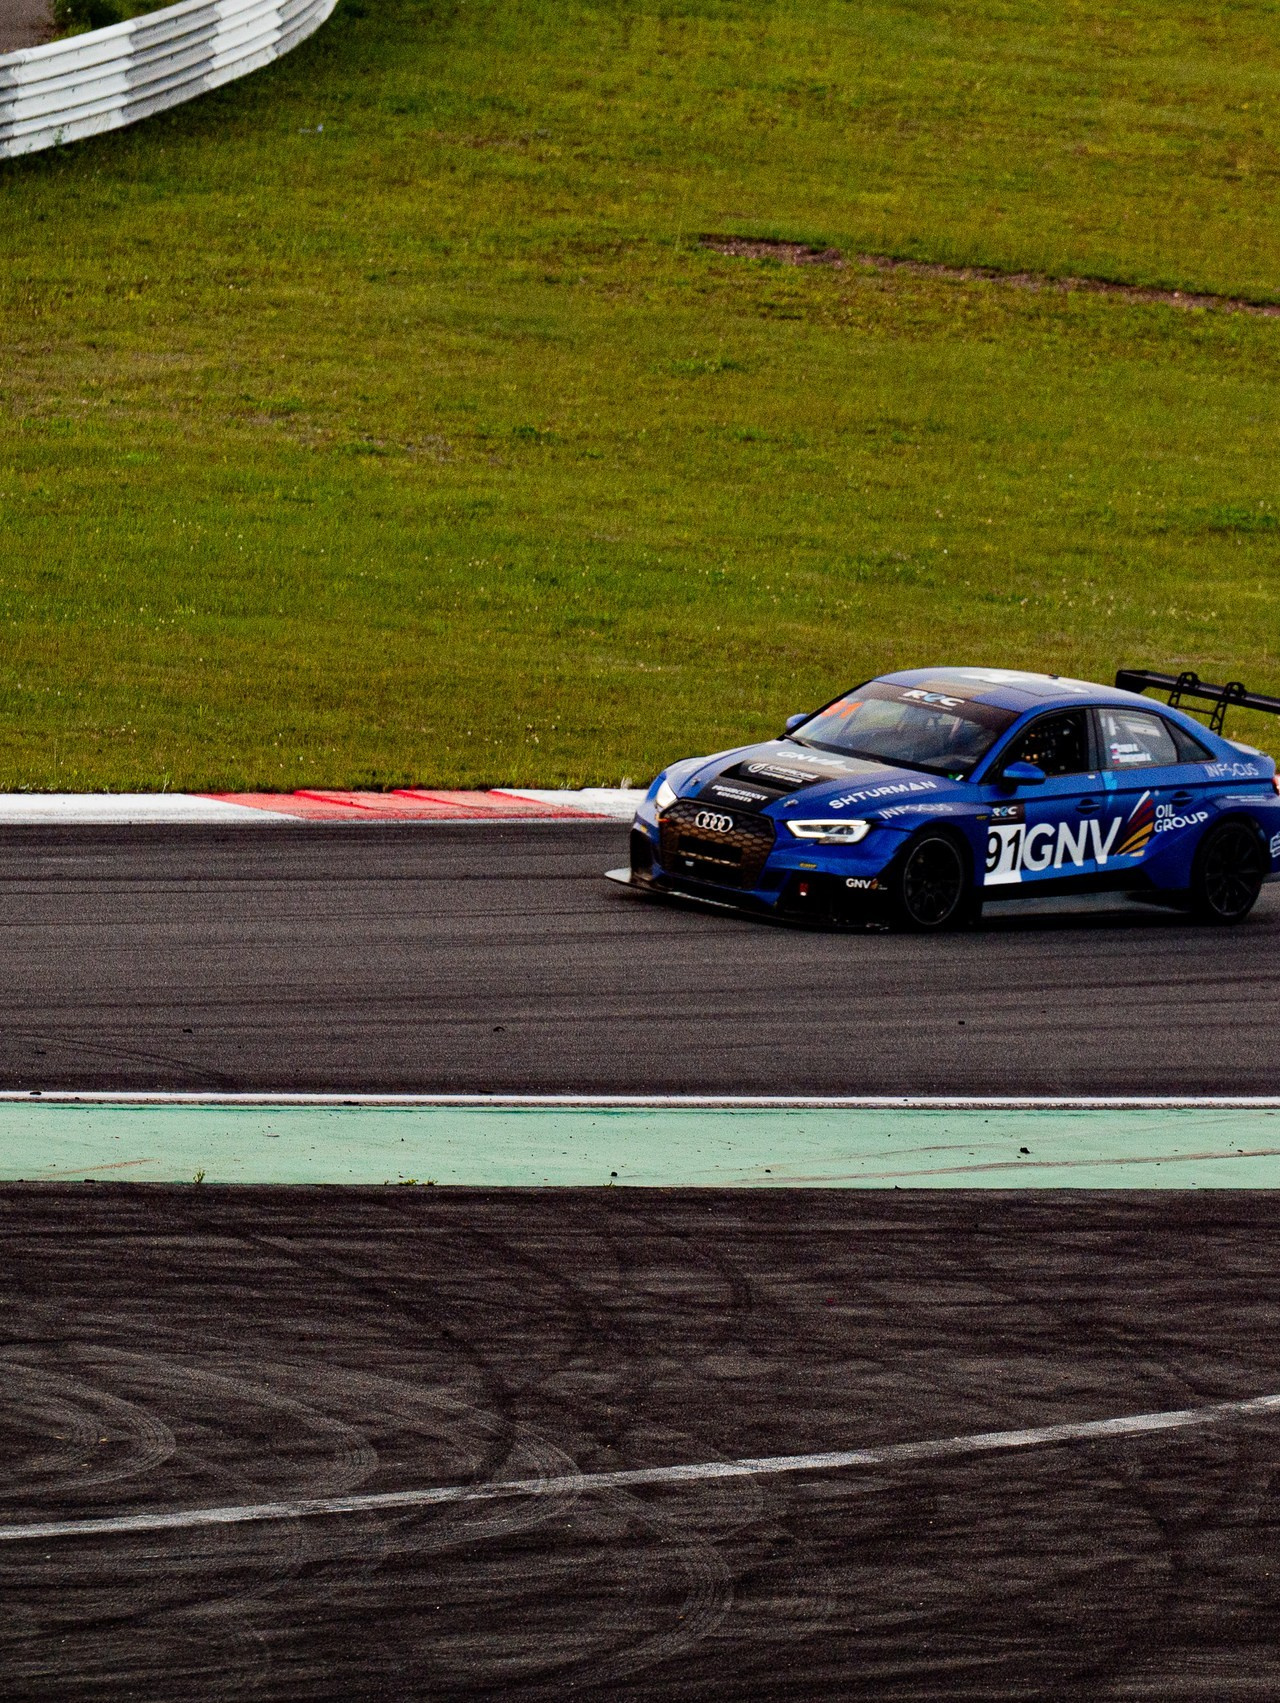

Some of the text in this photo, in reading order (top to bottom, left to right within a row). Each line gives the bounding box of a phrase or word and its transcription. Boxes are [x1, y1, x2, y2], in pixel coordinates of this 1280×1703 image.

[828, 780, 937, 810] SHTURMAN
[1154, 811, 1209, 833] GROUP
[1155, 804, 1176, 819] OIL
[985, 829, 1022, 874] 91
[1023, 816, 1123, 872] GNV
[845, 878, 871, 889] GNV
